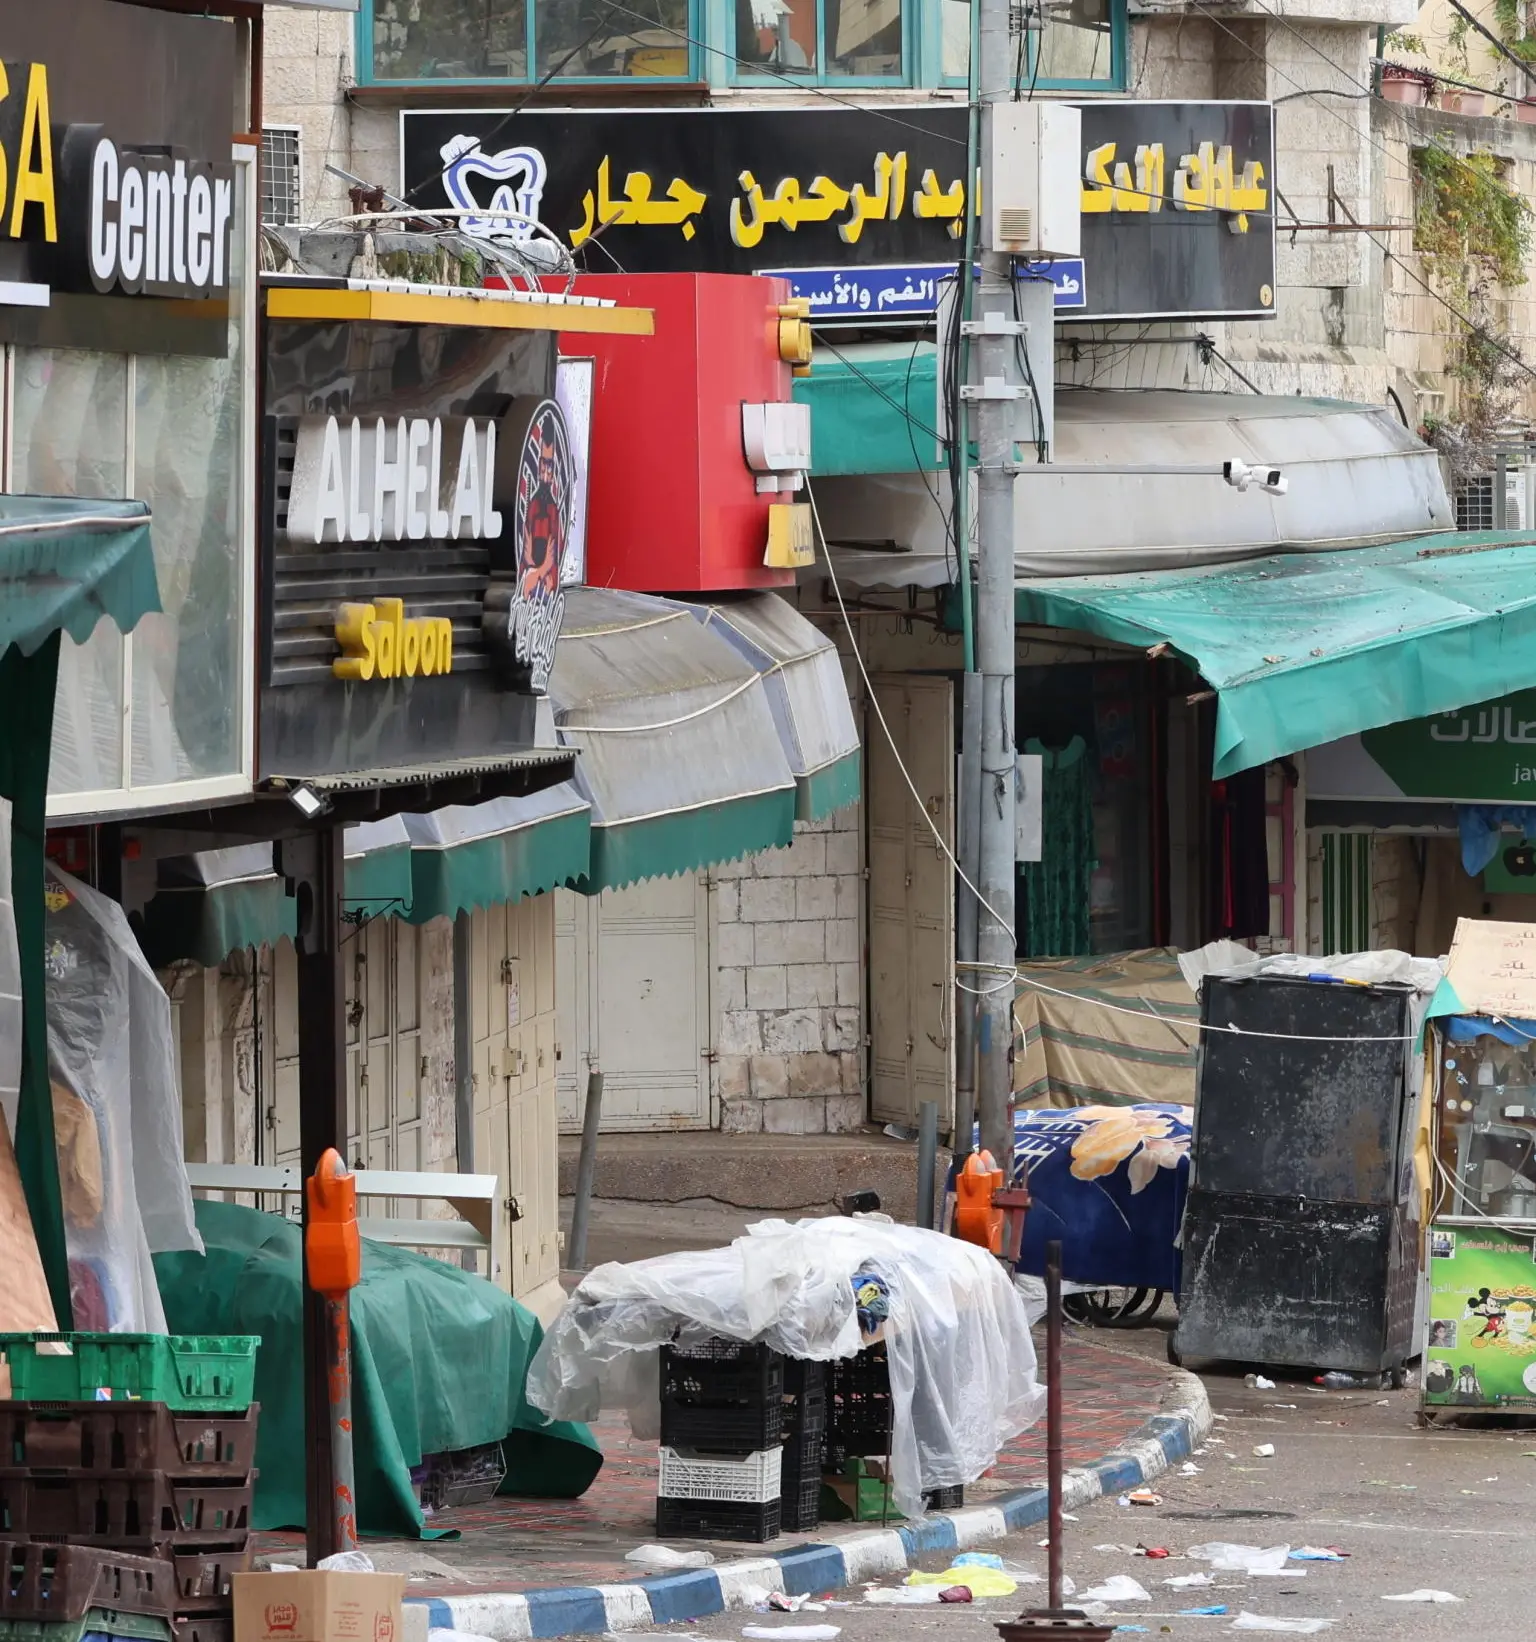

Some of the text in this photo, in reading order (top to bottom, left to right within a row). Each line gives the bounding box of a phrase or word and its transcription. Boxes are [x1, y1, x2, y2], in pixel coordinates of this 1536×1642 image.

[0, 57, 232, 287] A Center
[568, 154, 707, 247] جعار
[731, 150, 908, 248] الرحمن
[913, 167, 982, 239] بد
[1081, 142, 1164, 213] الدك
[877, 277, 934, 311] الفم
[314, 415, 502, 544] ALHELAL
[336, 597, 453, 681] Saloon
